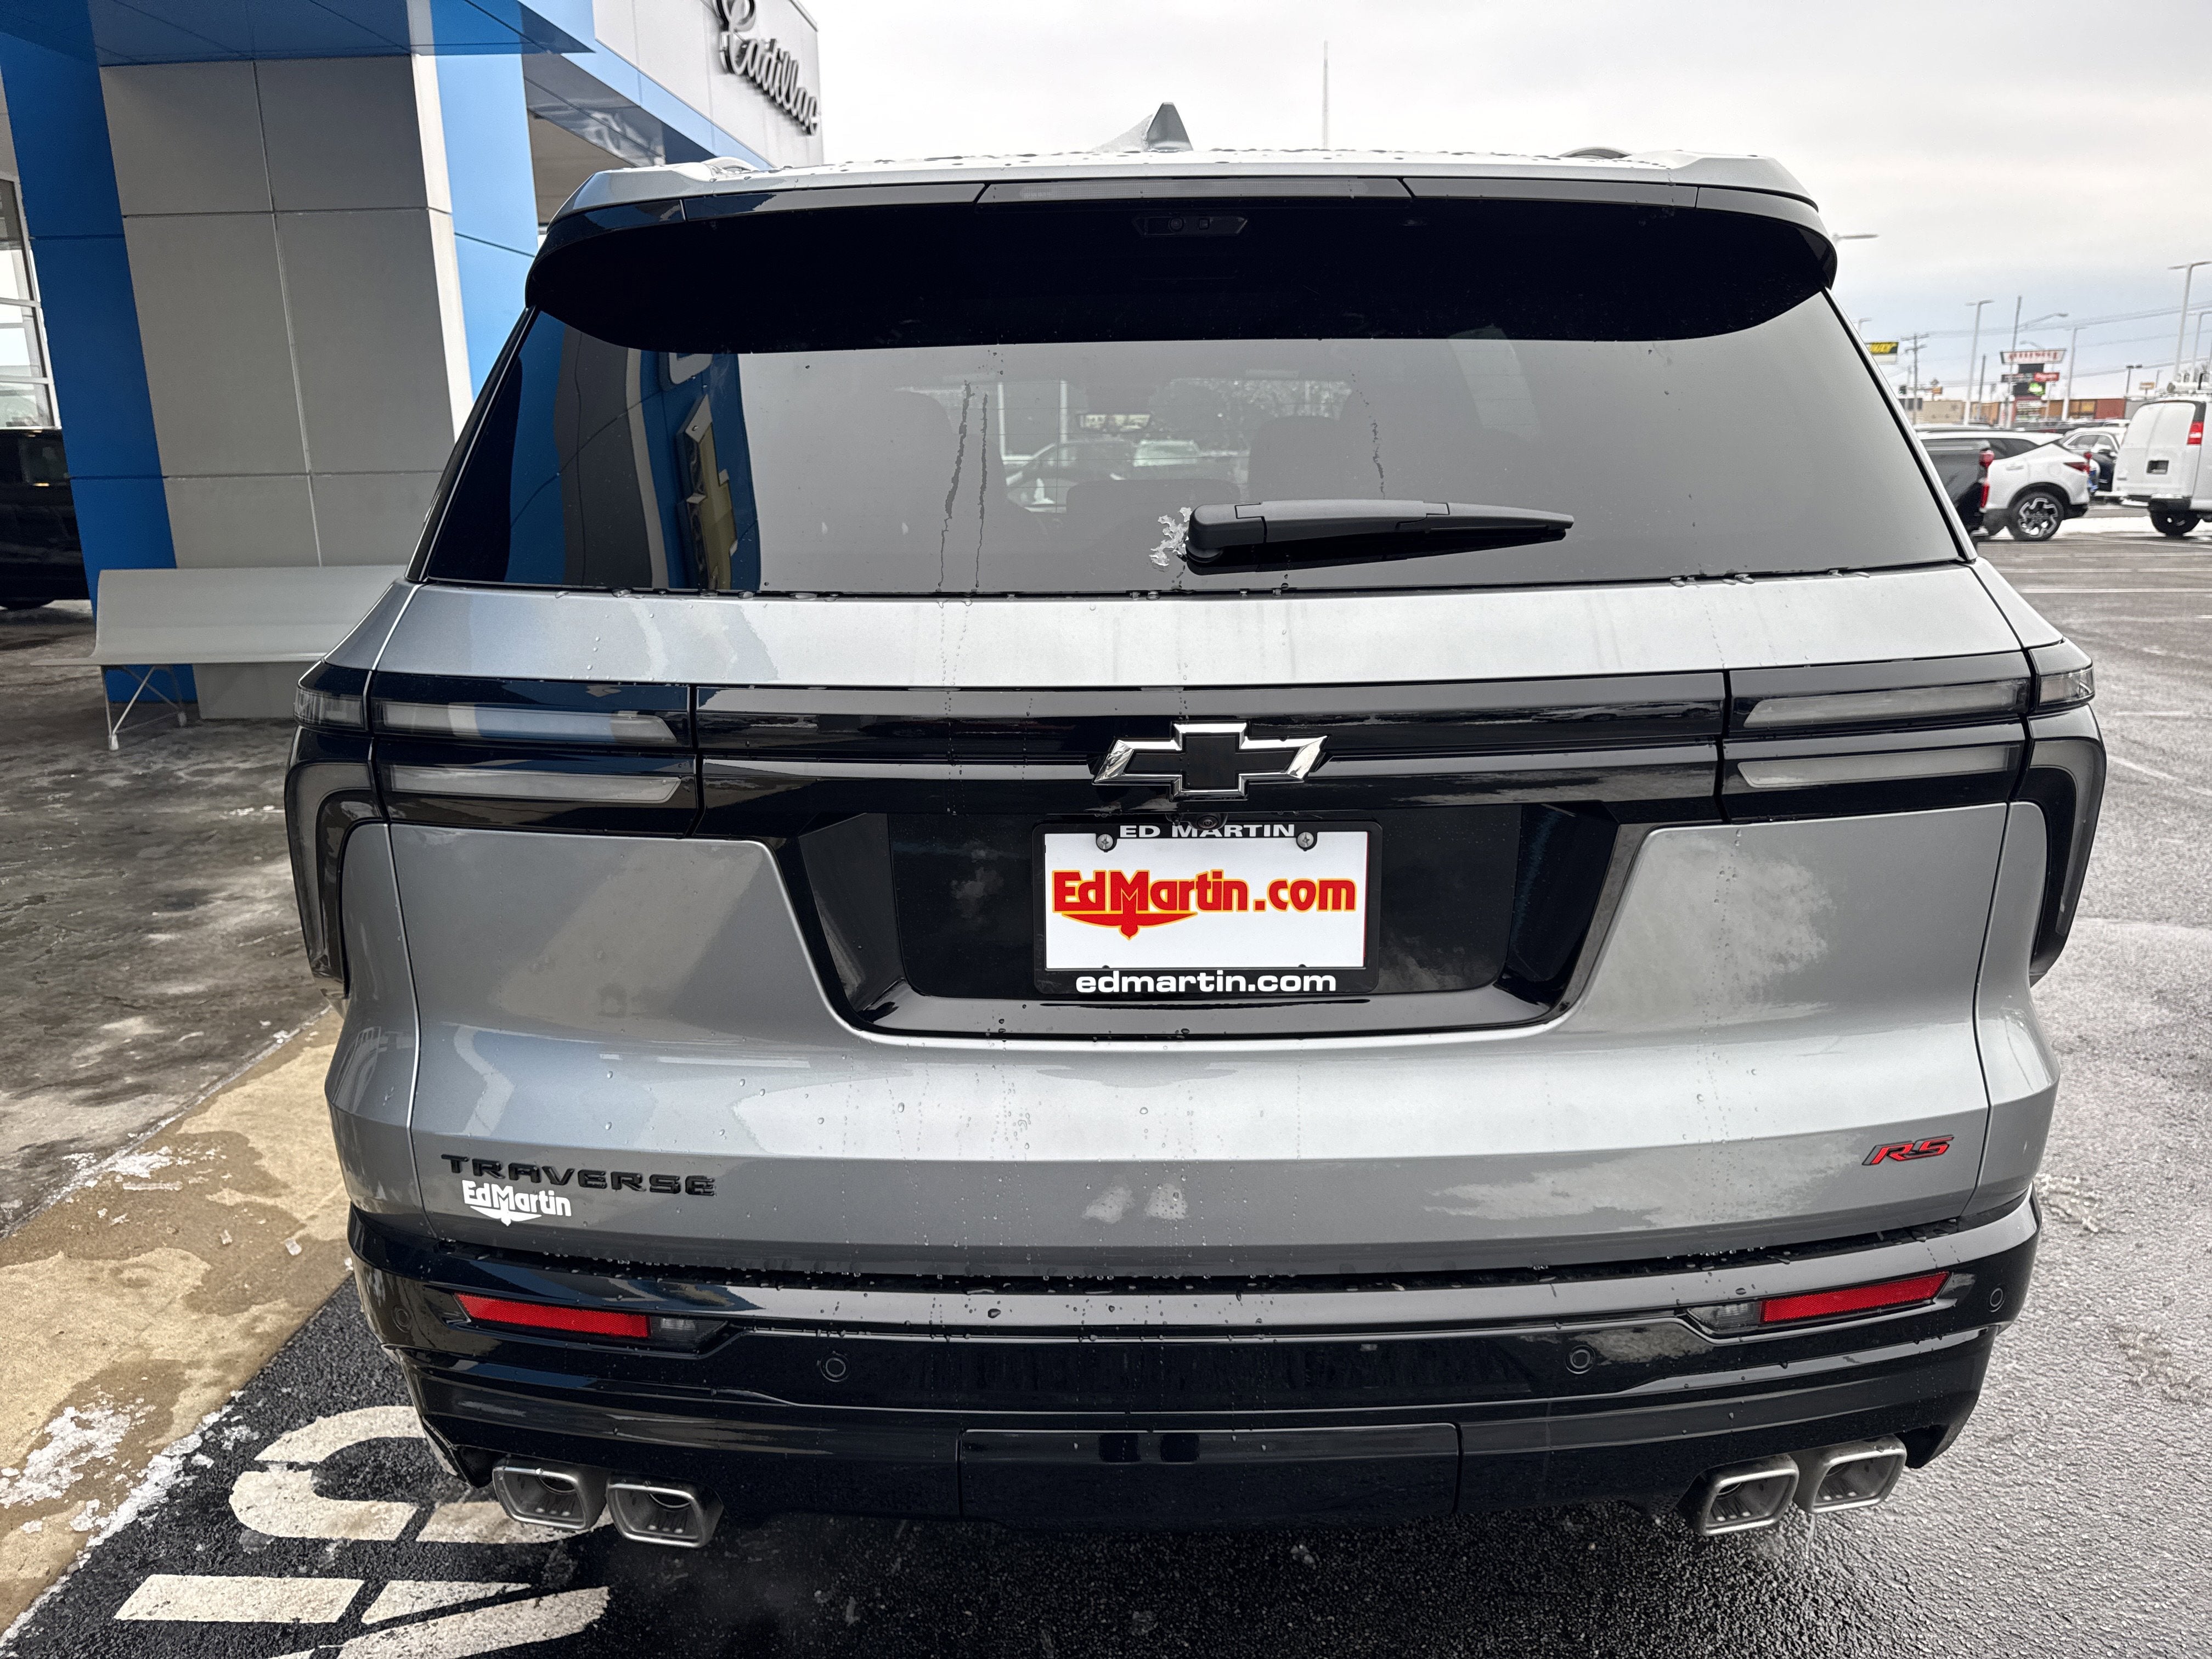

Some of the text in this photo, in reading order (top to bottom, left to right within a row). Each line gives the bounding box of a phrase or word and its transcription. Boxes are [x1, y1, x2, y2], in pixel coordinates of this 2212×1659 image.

[1120, 825, 1160, 837] ED
[1052, 870, 1357, 940] EdMartin.com
[1076, 970, 1336, 993] edmartin.com
[1862, 1134, 1955, 1165] RS
[441, 1154, 716, 1196] TRAVERSE
[462, 1180, 572, 1226] EdMartin
